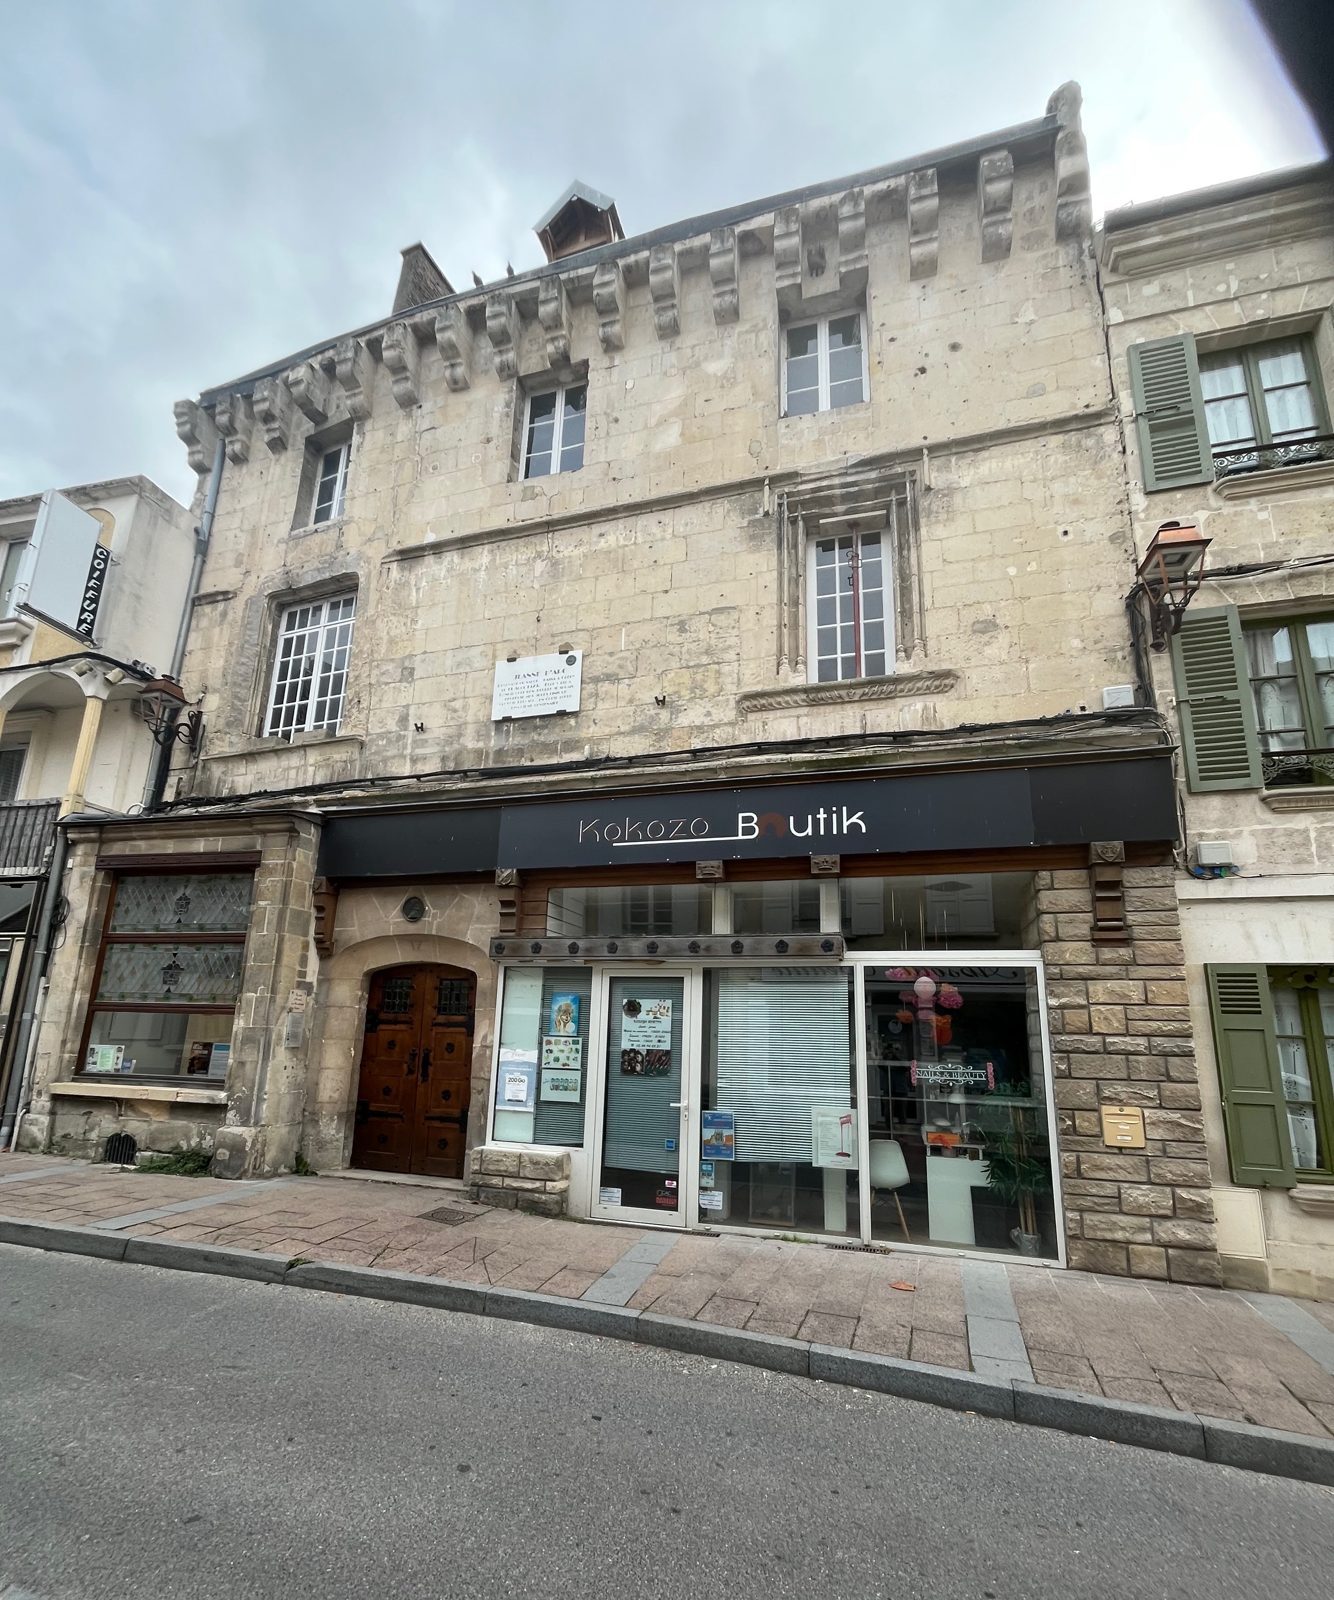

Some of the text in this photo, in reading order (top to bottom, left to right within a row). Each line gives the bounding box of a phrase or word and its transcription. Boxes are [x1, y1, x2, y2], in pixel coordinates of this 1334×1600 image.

[78, 548, 108, 634] COIFFURE
[579, 816, 710, 844] Kokozo
[916, 1070, 941, 1078] NAILS
